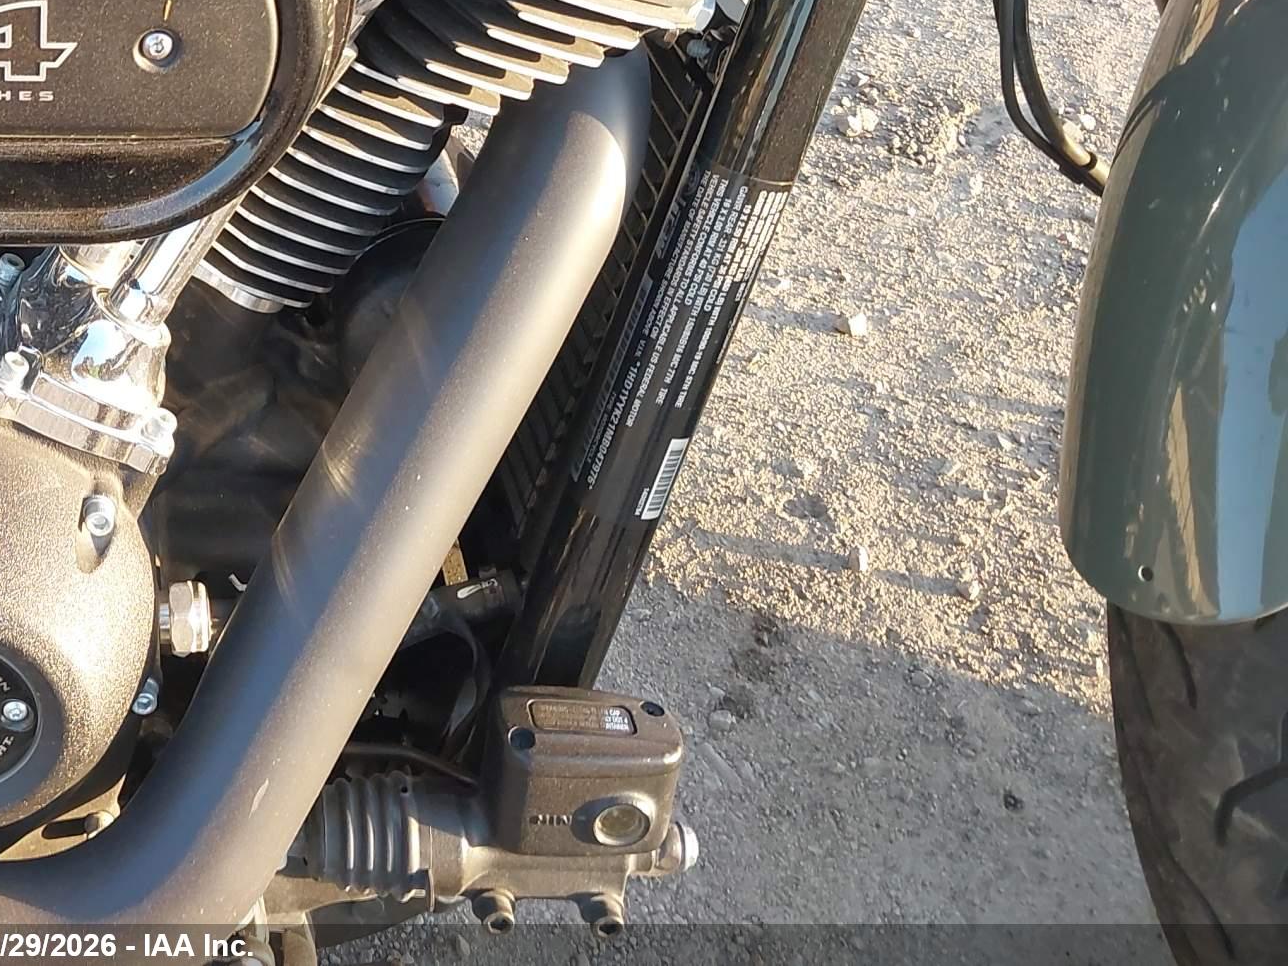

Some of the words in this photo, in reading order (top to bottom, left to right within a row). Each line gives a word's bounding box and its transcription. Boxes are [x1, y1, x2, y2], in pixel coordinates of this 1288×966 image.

[700, 169, 712, 187] THE
[715, 178, 729, 197] THIS
[691, 185, 705, 208] DATE
[700, 174, 720, 209] VEHICLE
[687, 207, 696, 221] OF
[689, 207, 706, 240] SAFETY
[701, 197, 721, 232] VEHICLE
[723, 210, 739, 234] REAR
[741, 215, 758, 244] FRONT
[664, 220, 691, 279] MANUFACTURE
[684, 231, 707, 277] CONFORMS
[702, 246, 713, 260] AT
[711, 252, 722, 266] KG
[722, 252, 732, 265] AT
[670, 238, 694, 287] STANDARDS
[679, 277, 690, 290] TO
[692, 268, 704, 283] PSI
[712, 274, 724, 289] PSI
[652, 278, 668, 309] SHOWN
[666, 286, 675, 297] IN
[672, 288, 685, 305] ALL
[684, 282, 698, 306] COLD
[703, 288, 718, 312] COLD
[655, 295, 672, 327] EFFECT
[690, 296, 704, 316] WITH
[708, 306, 721, 326] WITH
[642, 307, 657, 336] ABOVE
[654, 303, 678, 352] APPLICABLE
[649, 325, 659, 339] ON
[650, 351, 660, 364] US
[636, 363, 655, 397] FEDERAL
[663, 368, 676, 384] 77H
[655, 387, 668, 405] TIRE
[674, 390, 687, 408] TIRE
[625, 398, 641, 427] MOTOR
